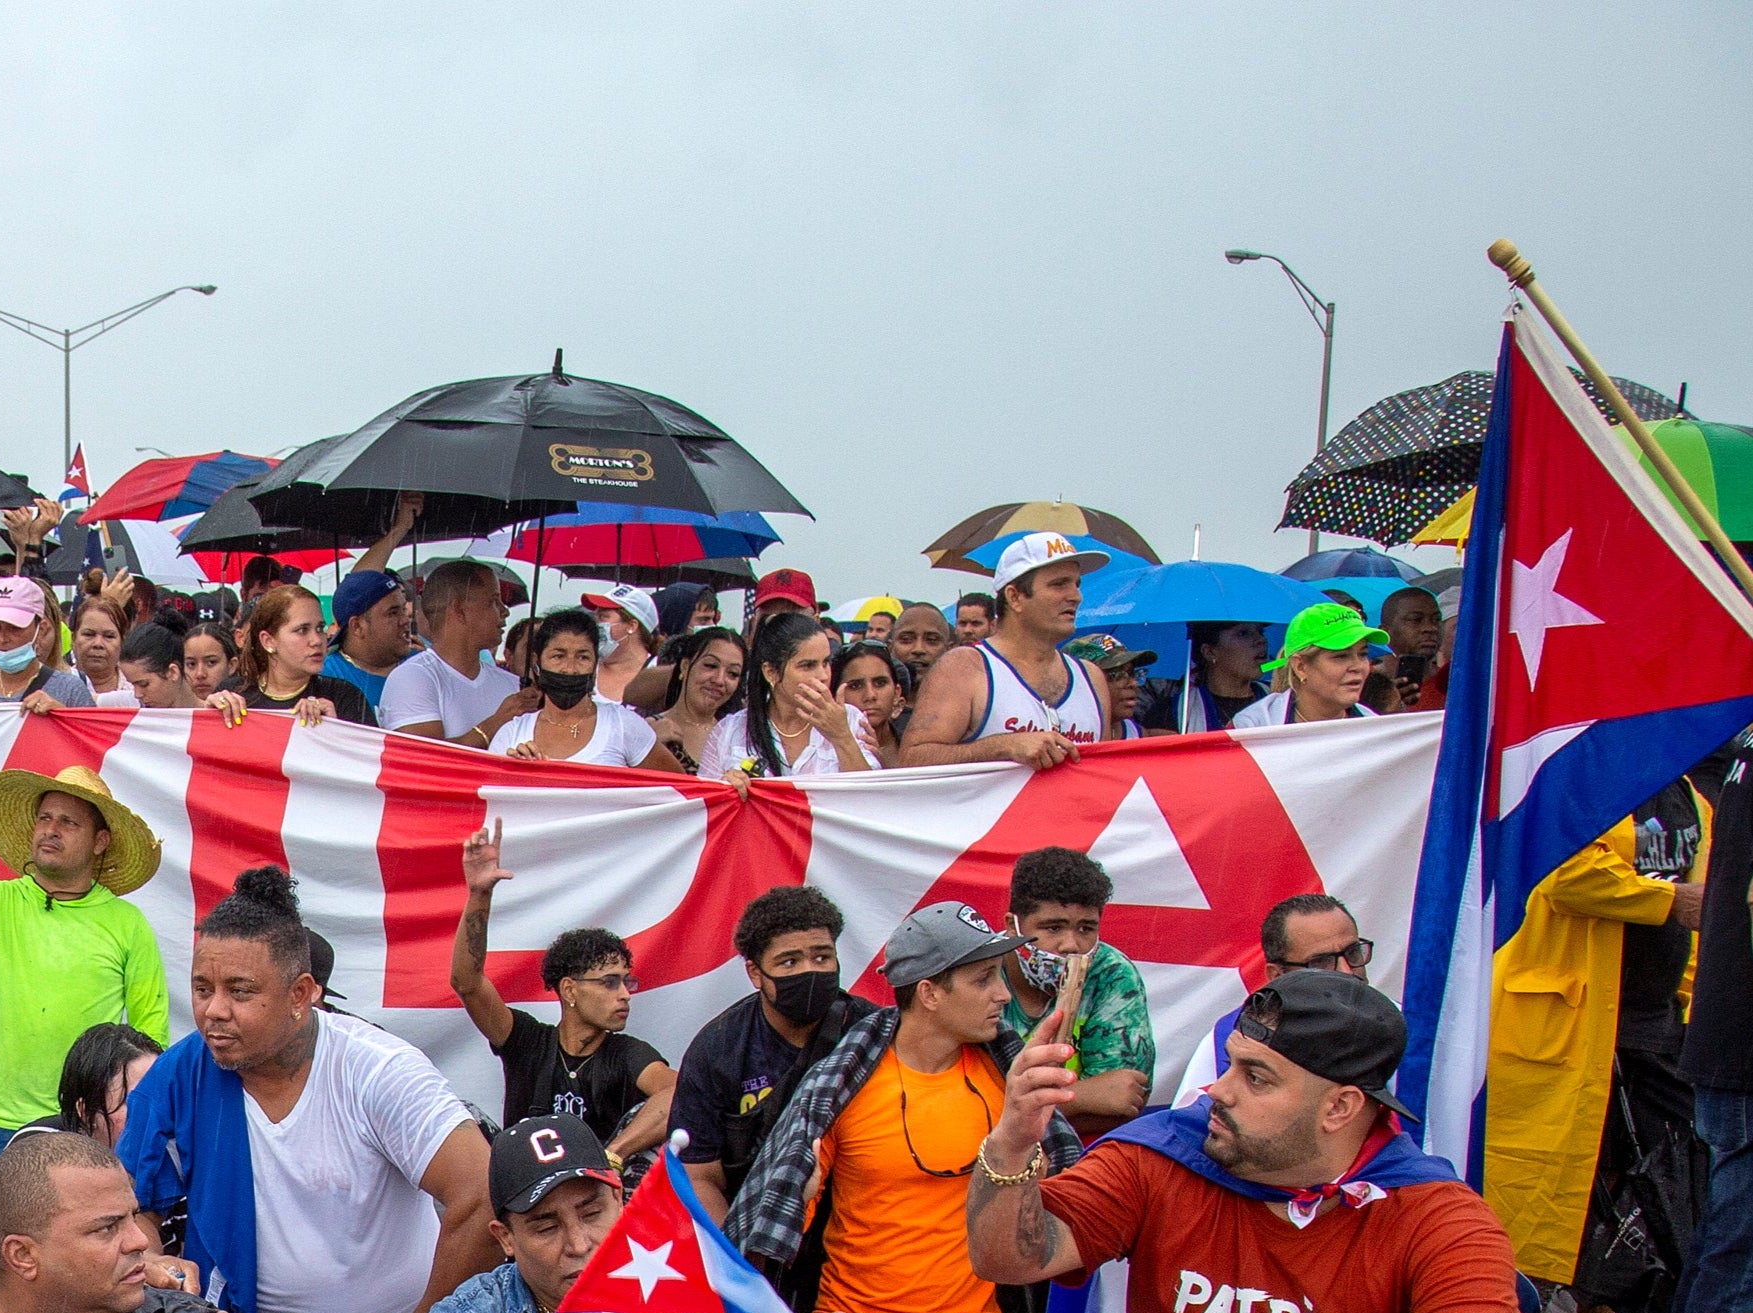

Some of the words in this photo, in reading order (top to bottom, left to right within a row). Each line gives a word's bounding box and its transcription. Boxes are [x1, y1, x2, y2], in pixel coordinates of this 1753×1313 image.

[568, 456, 635, 469] MORTON'S
[571, 476, 589, 484] THE
[589, 478, 639, 488] STEAKHOUSE
[529, 1128, 565, 1163] C
